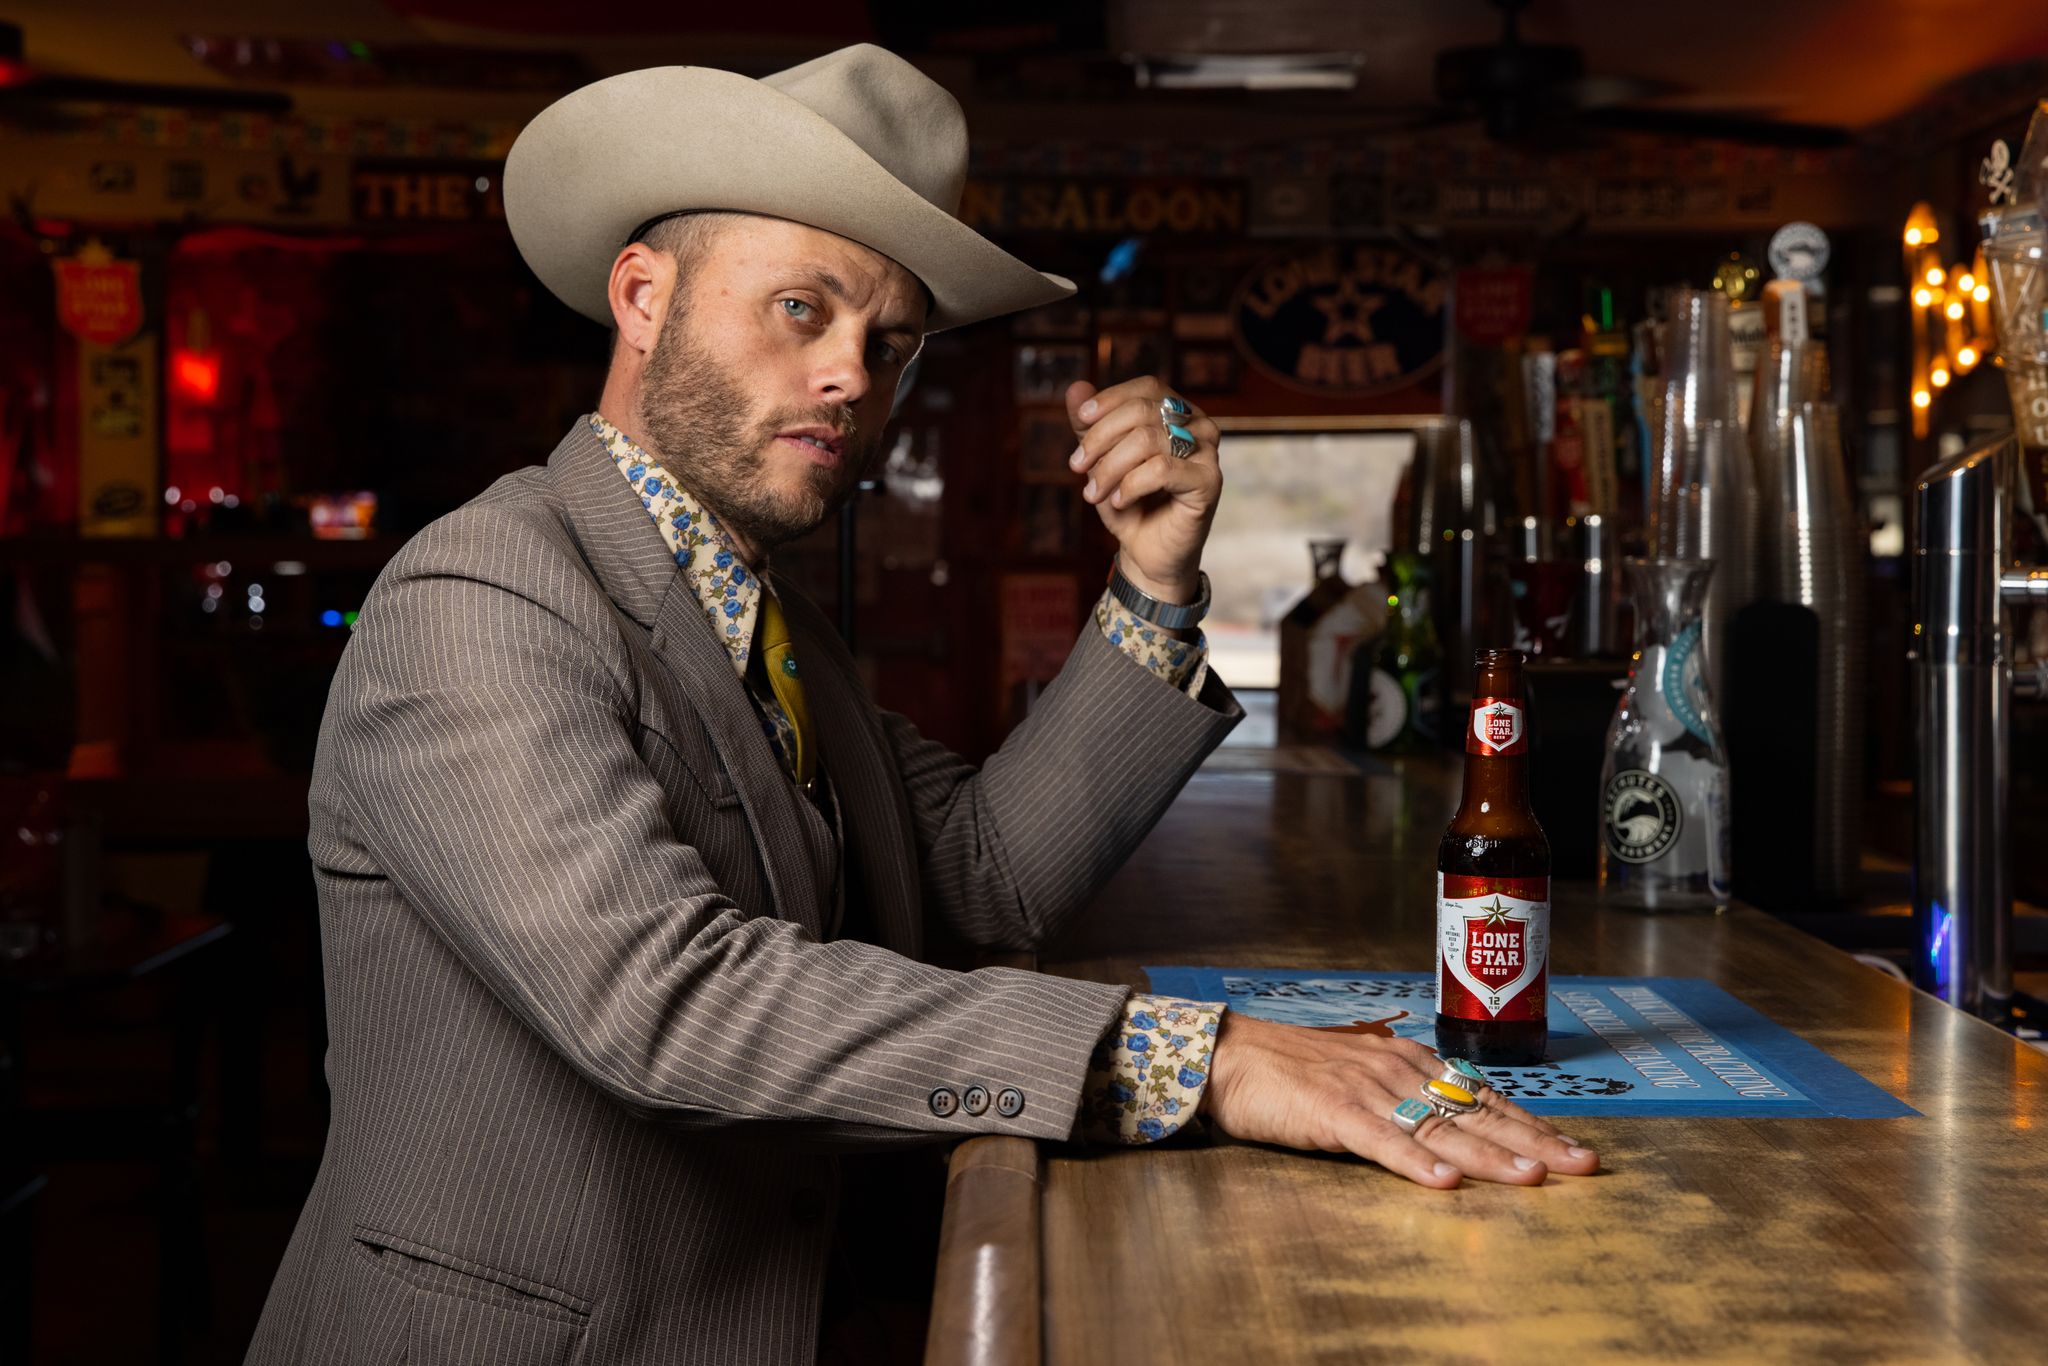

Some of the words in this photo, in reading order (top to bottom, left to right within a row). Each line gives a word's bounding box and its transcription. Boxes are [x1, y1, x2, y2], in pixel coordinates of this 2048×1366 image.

[352, 173, 470, 219] THE
[1019, 184, 1243, 232] SALOON
[1488, 719, 1511, 727] LONE
[1471, 931, 1520, 949] LONE
[1471, 949, 1521, 966] STAR
[1482, 967, 1508, 976] BEER
[1488, 996, 1501, 1006] 12
[1602, 1034, 1701, 1088] DISTANCING
[1680, 1044, 1788, 1097] PRACTICING
